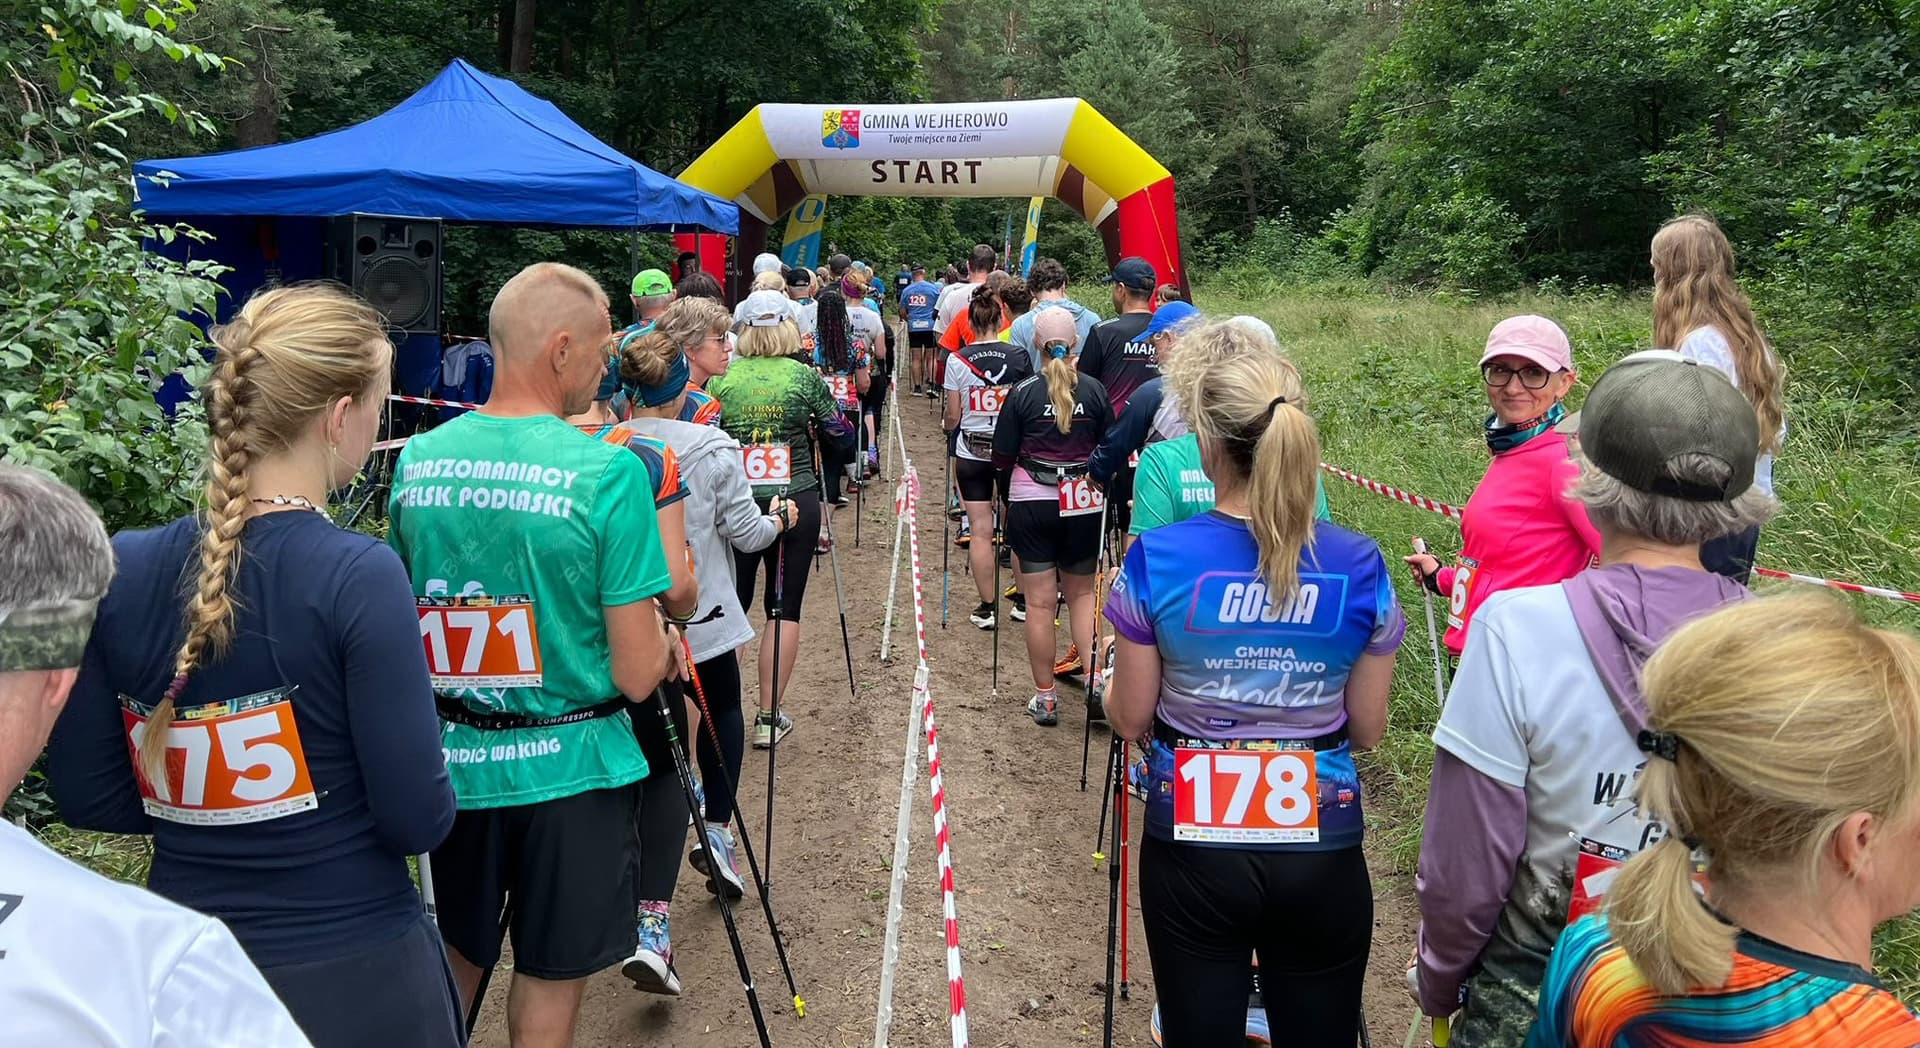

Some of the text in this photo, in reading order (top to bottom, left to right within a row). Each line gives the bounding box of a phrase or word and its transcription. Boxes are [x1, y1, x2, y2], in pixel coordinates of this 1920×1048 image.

[863, 112, 1008, 129] GMINA WEJHEROWO
[888, 133, 982, 144] Twoje miejsce na Ziemi
[871, 160, 982, 184] START
[909, 295, 926, 304] 120
[403, 458, 578, 489] MARSZOMANIACY
[745, 448, 788, 479] 63
[458, 486, 573, 519] PODLASKI
[418, 608, 537, 673] 171
[1234, 646, 1296, 659] GMINA
[1203, 658, 1326, 673] WEJHEROWO
[441, 746, 487, 766] ORDIC
[1179, 754, 1312, 825] 178
